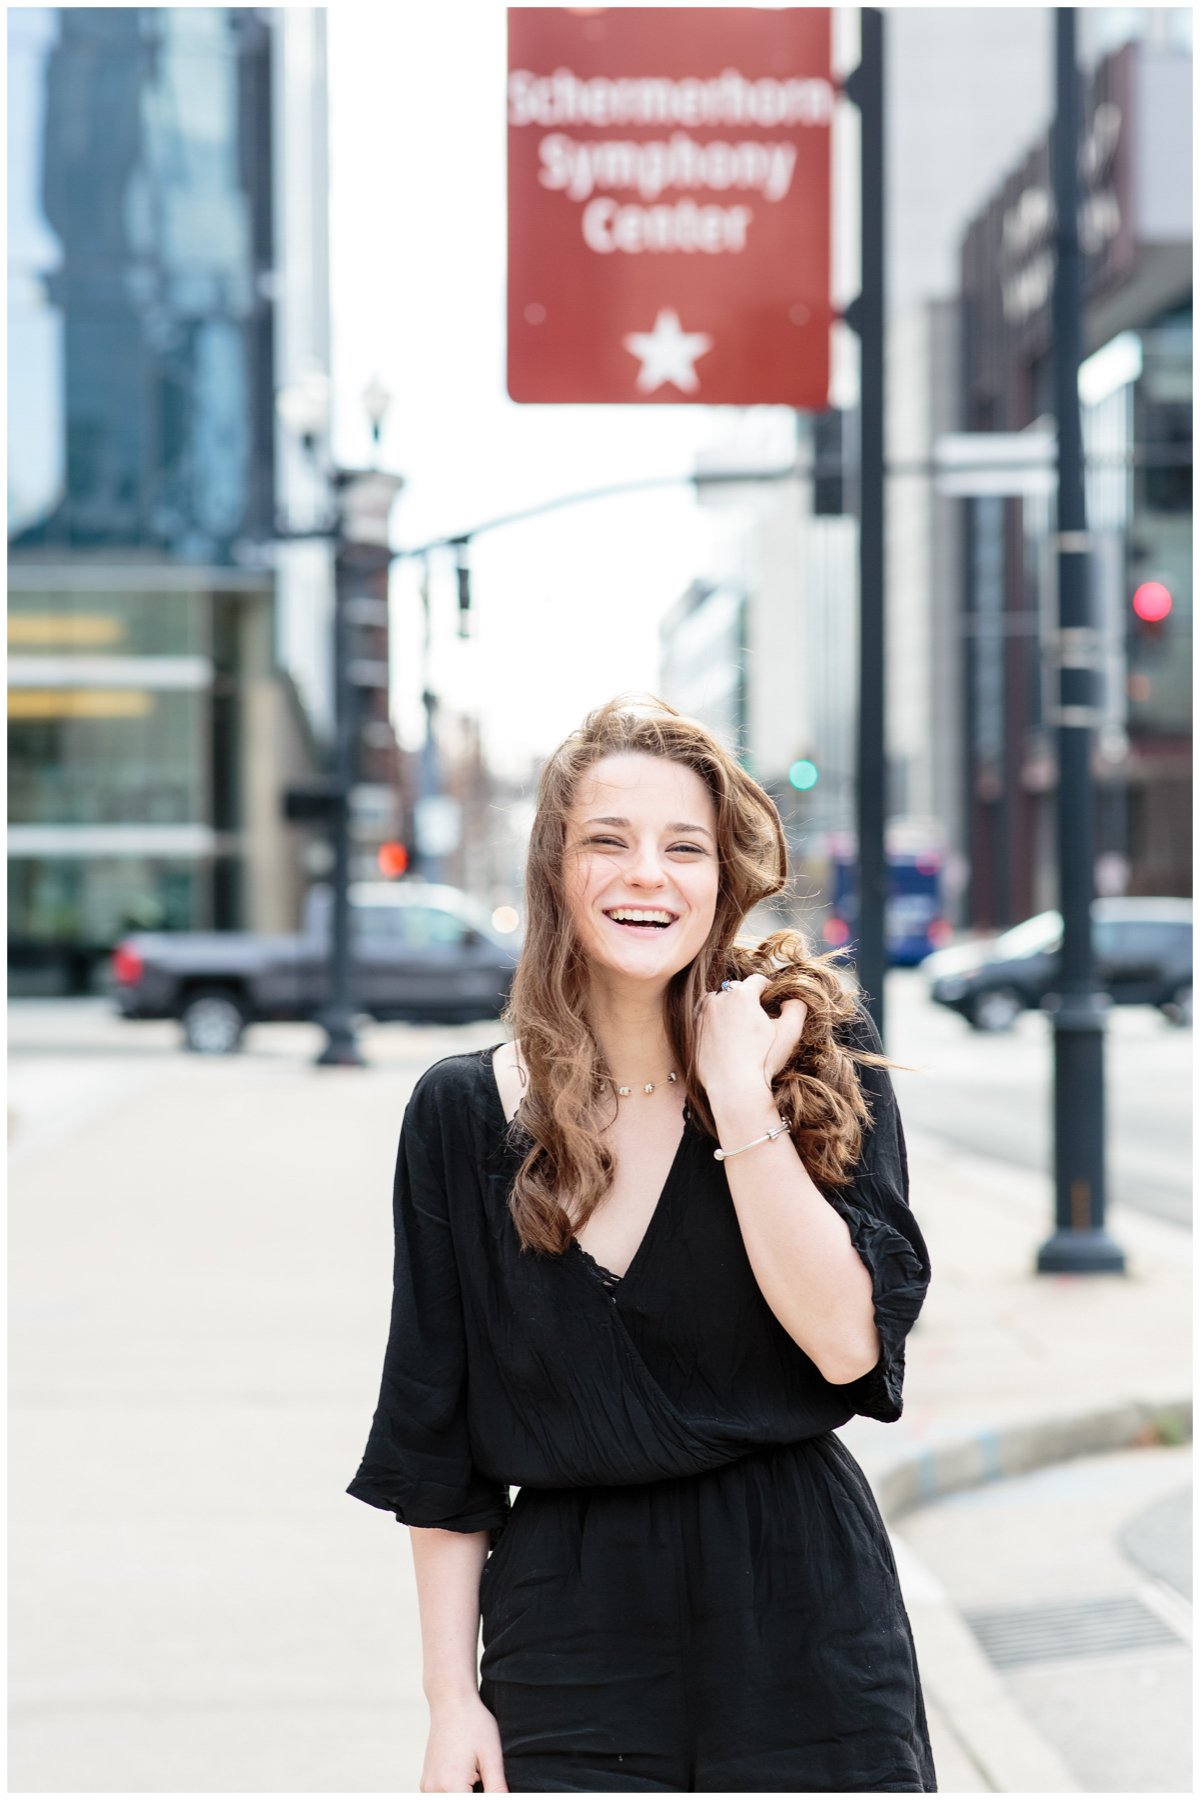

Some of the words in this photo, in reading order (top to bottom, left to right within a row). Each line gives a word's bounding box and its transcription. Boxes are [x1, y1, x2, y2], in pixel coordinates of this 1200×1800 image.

[508, 68, 834, 126] Schermerhorn
[537, 133, 797, 202] Symphony
[581, 197, 753, 254] Center
